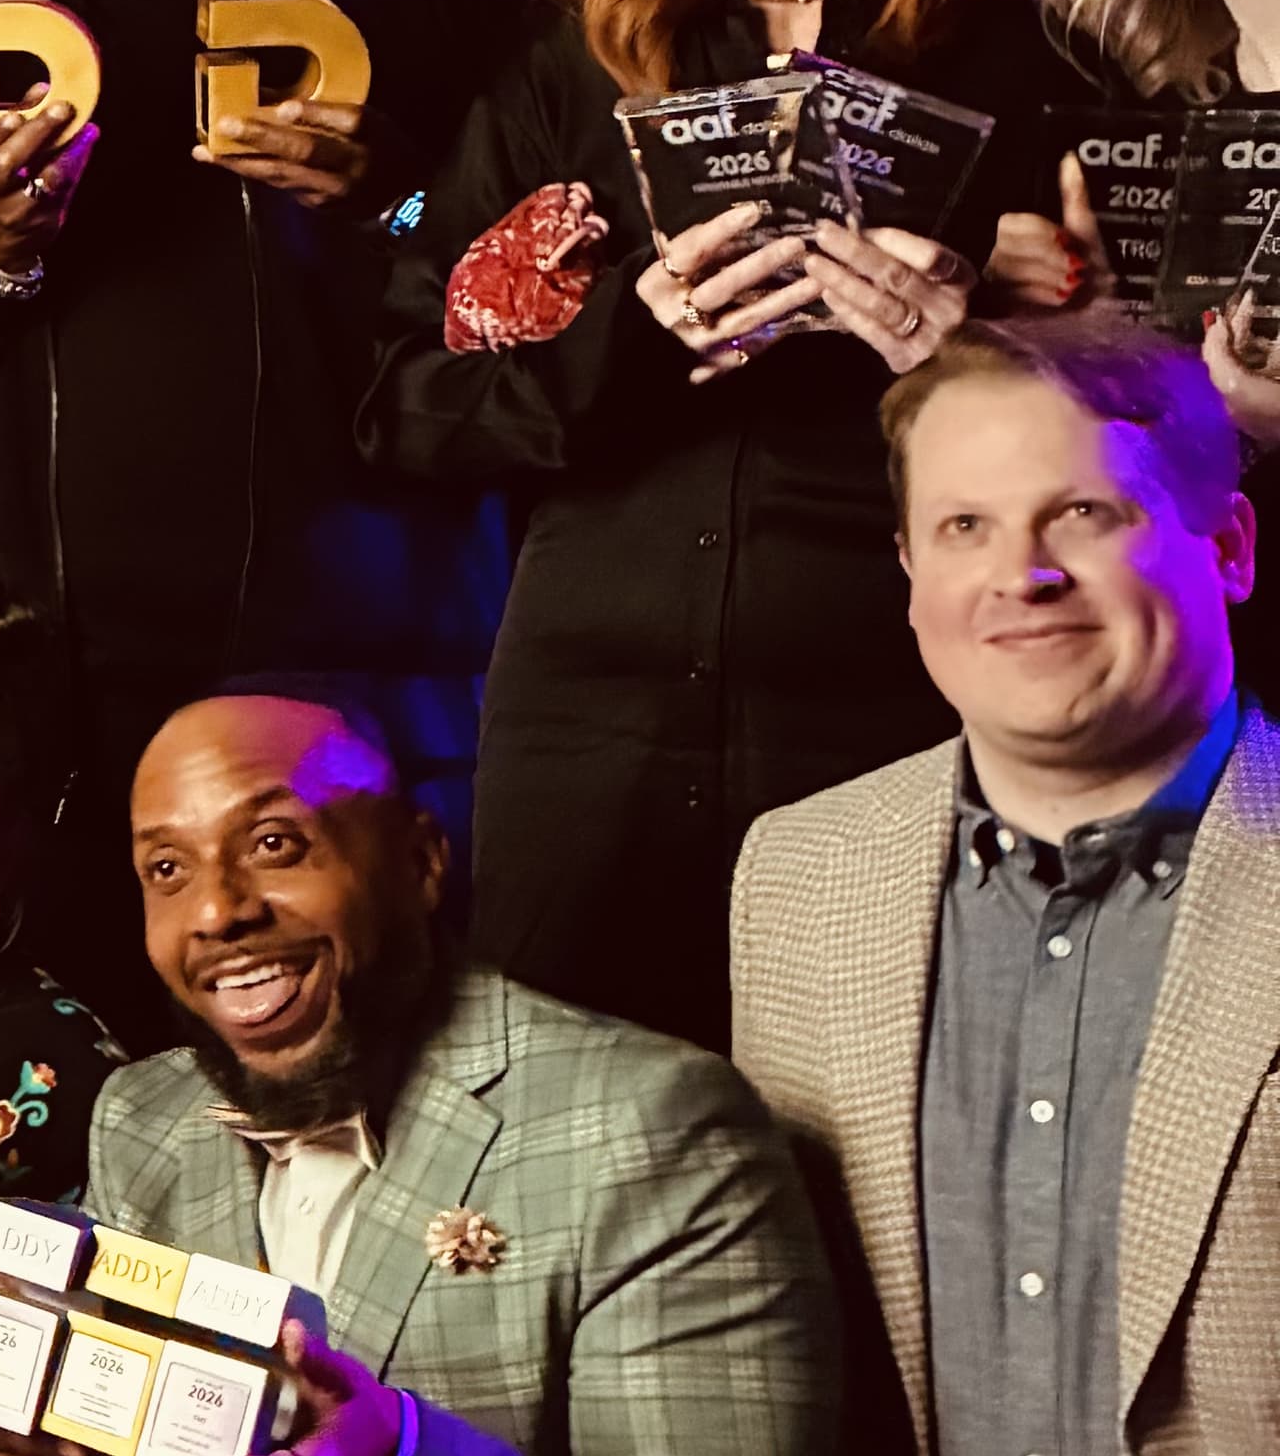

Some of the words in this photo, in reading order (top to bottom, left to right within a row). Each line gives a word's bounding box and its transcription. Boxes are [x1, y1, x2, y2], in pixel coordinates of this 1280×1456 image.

[661, 105, 738, 145] aaf
[704, 150, 771, 178] 2026
[1078, 133, 1163, 169] aaf
[91, 1247, 172, 1291] ADDY
[89, 1352, 125, 1376] 2026
[187, 1384, 225, 1408] 2026
